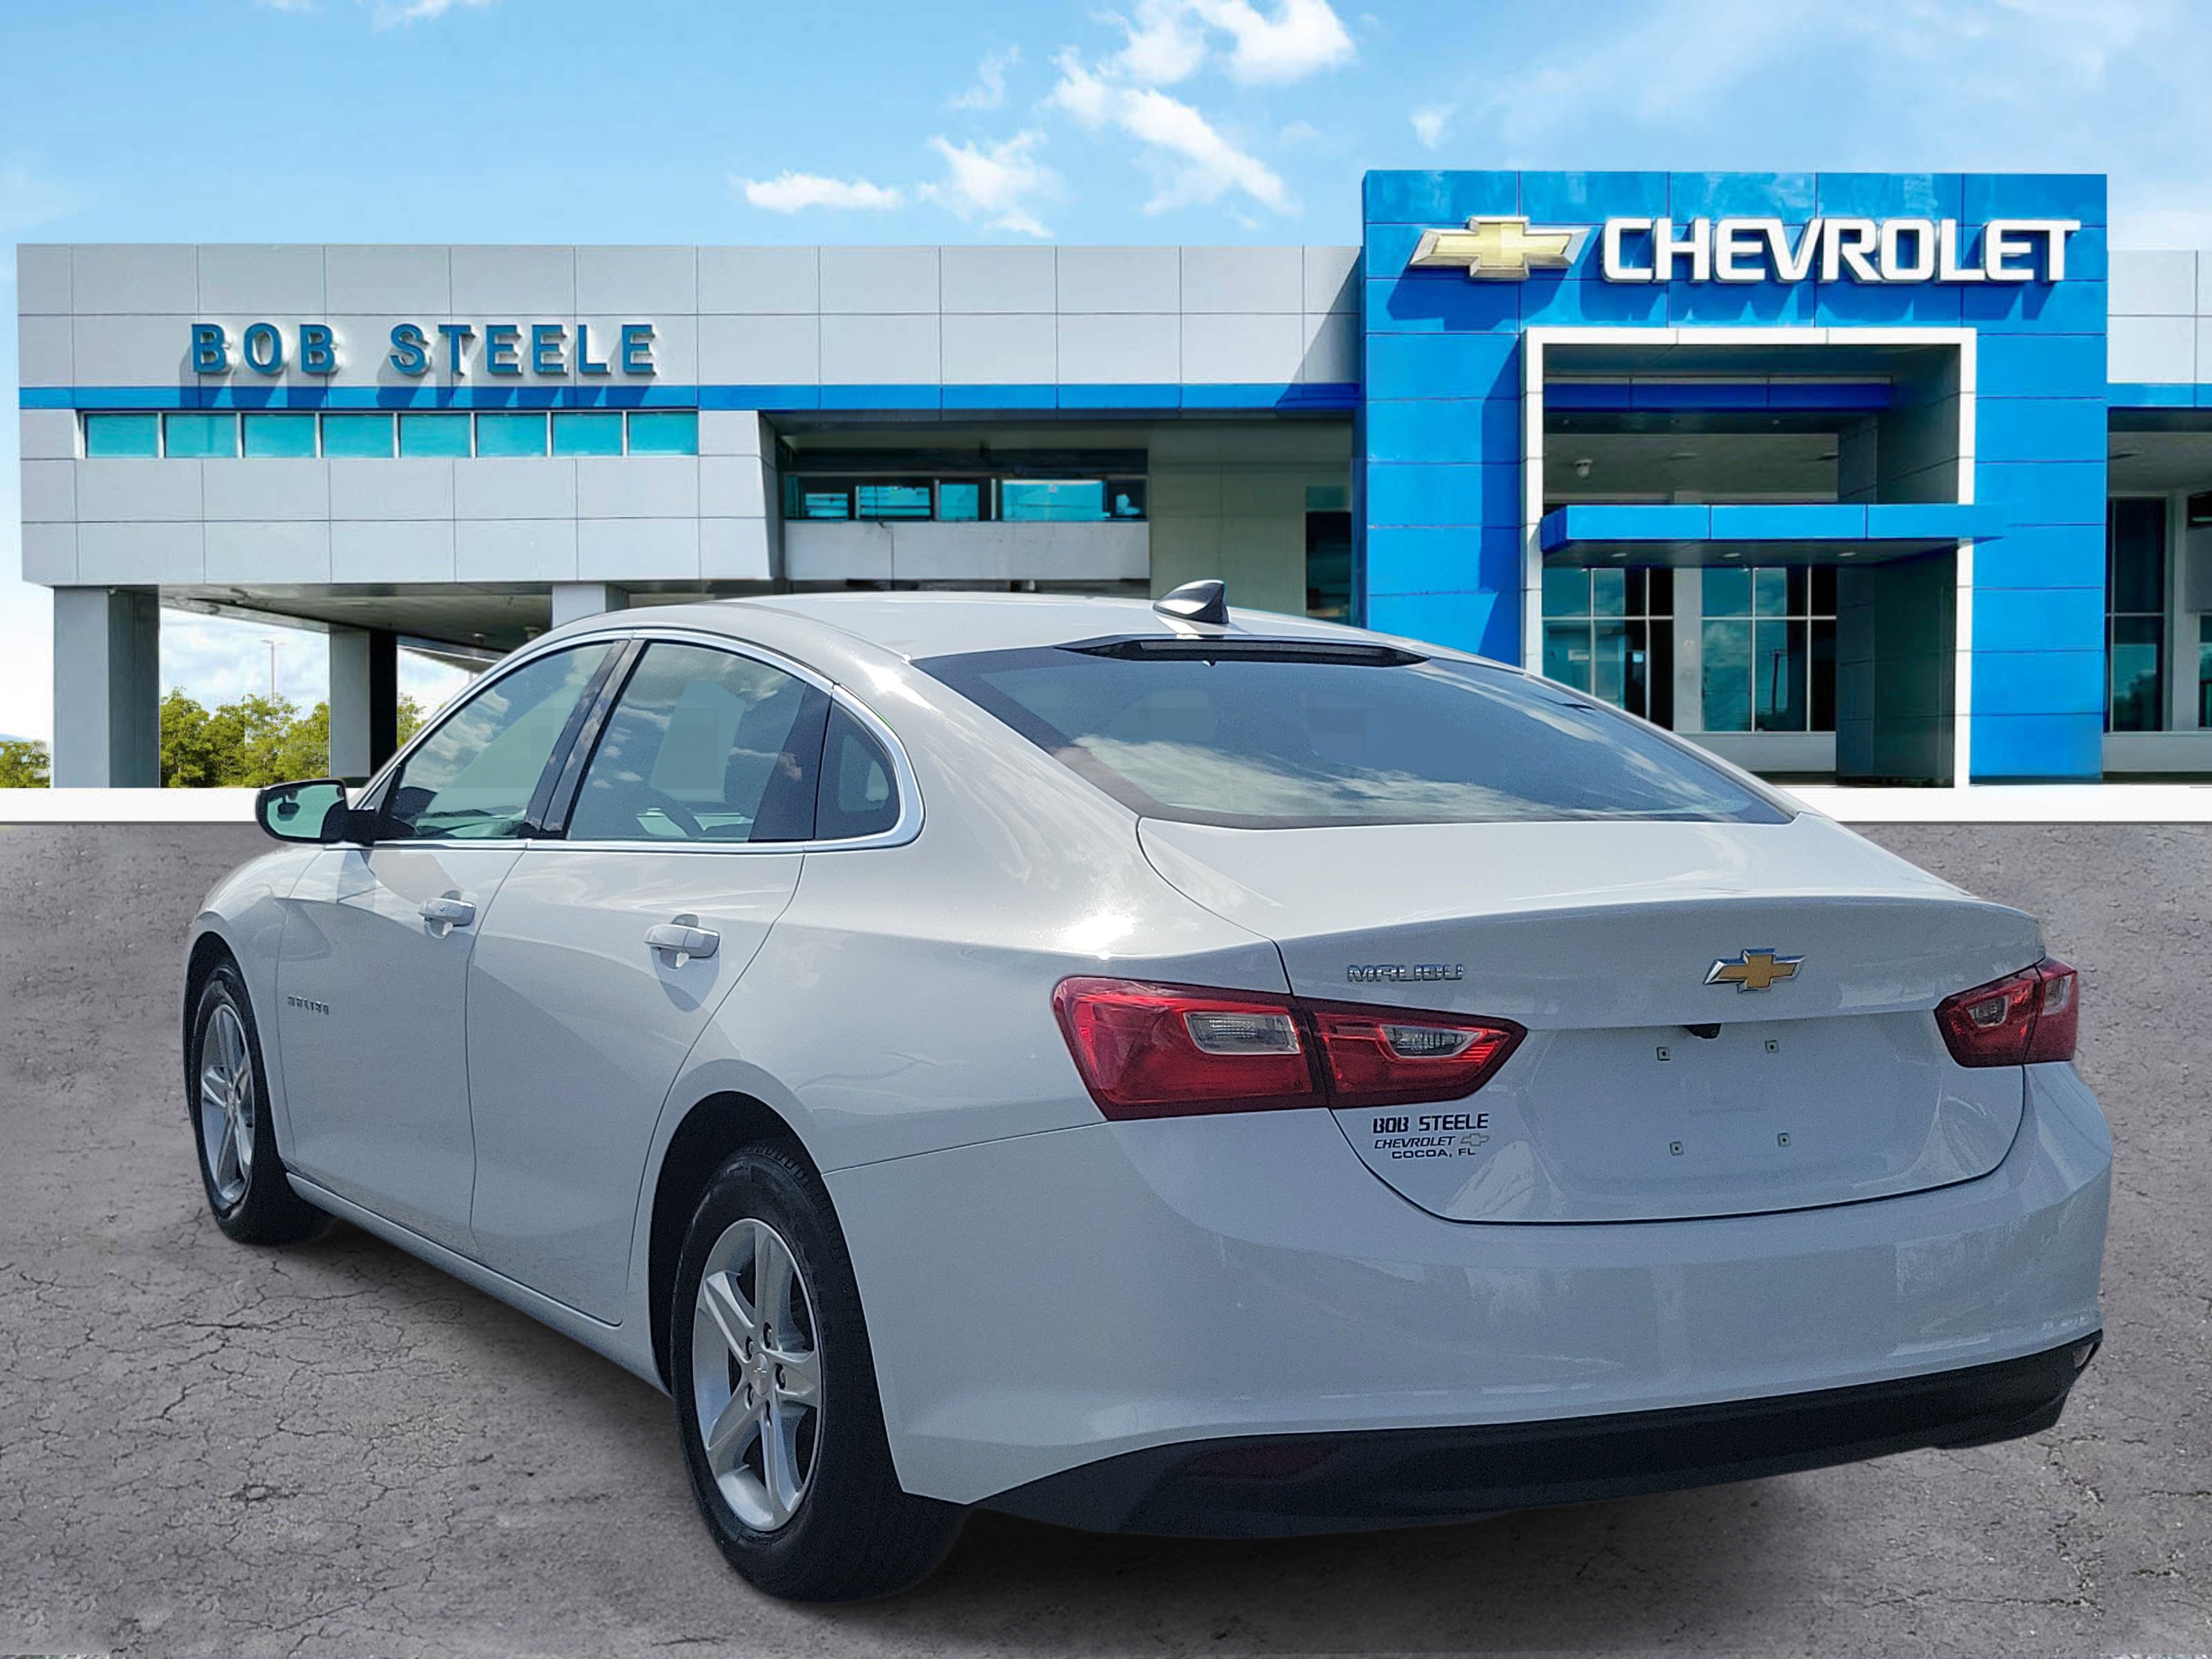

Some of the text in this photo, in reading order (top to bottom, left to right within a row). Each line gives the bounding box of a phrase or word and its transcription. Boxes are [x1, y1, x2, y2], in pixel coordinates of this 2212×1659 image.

[1602, 218, 2081, 283] CHEVROLET
[191, 323, 655, 375] BOB STEELE
[1347, 964, 1464, 982] MALIBU
[1373, 1114, 1489, 1133] BOB STEELE
[1374, 1136, 1456, 1149] CHEVROLET
[1391, 1150, 1452, 1159] COCOA,
